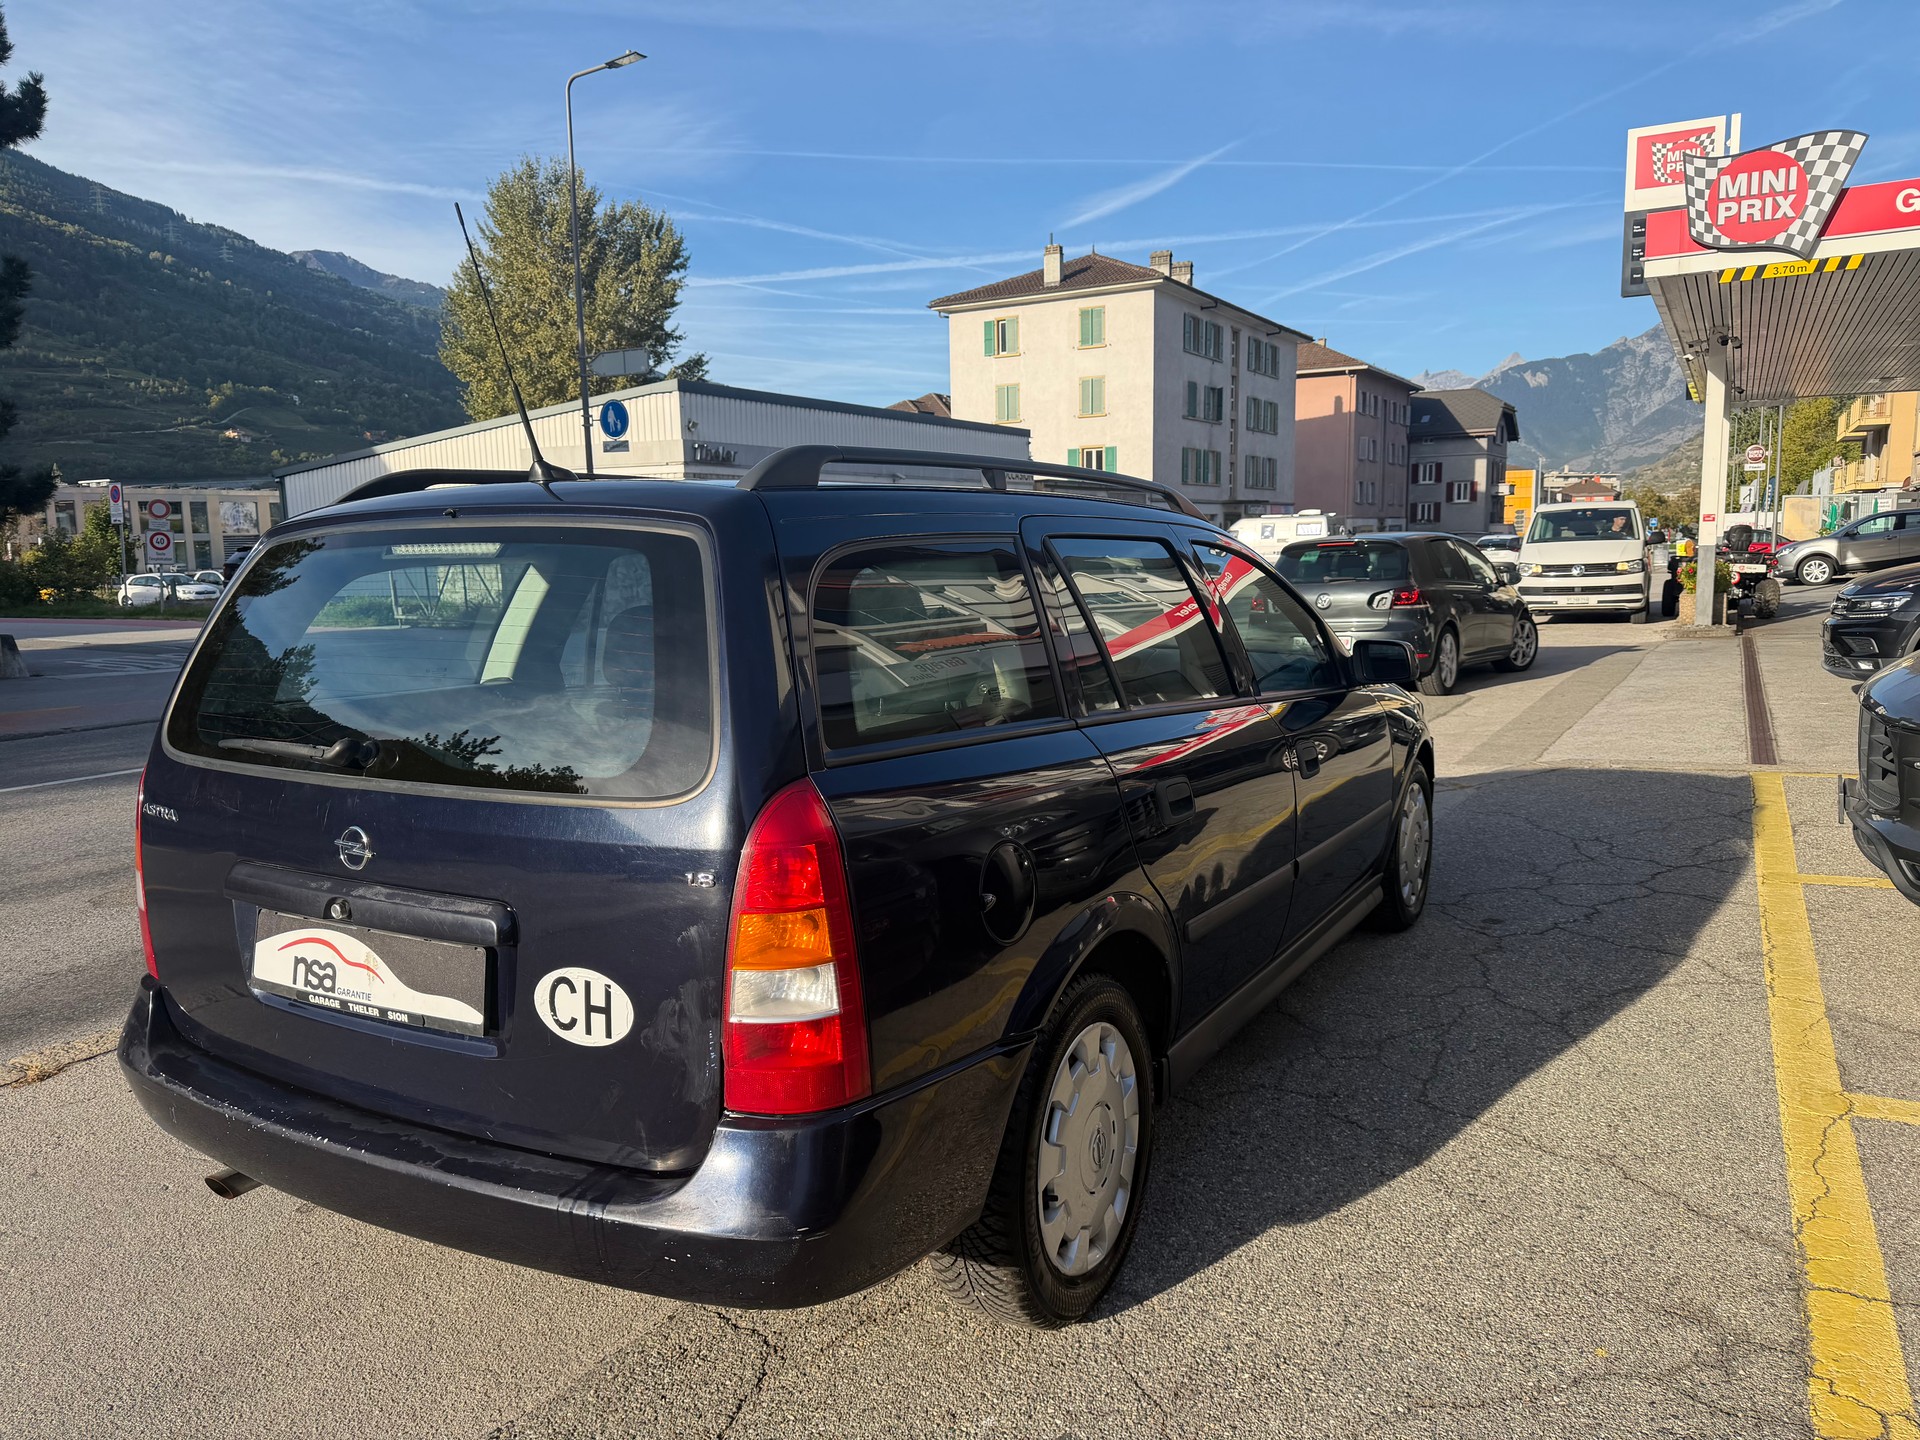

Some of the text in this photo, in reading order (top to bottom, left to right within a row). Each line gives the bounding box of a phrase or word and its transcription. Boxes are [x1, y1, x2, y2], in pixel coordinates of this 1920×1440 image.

[1666, 161, 1685, 174] PR
[1718, 166, 1798, 200] MINI
[1716, 194, 1797, 226] PRIX
[155, 537, 165, 545] 40
[142, 803, 179, 822] ASTRA
[292, 955, 337, 994] nsa
[308, 994, 409, 1023] GARAGE THELER SION
[336, 987, 373, 1002] GARANTIE
[548, 976, 613, 1040] CH
